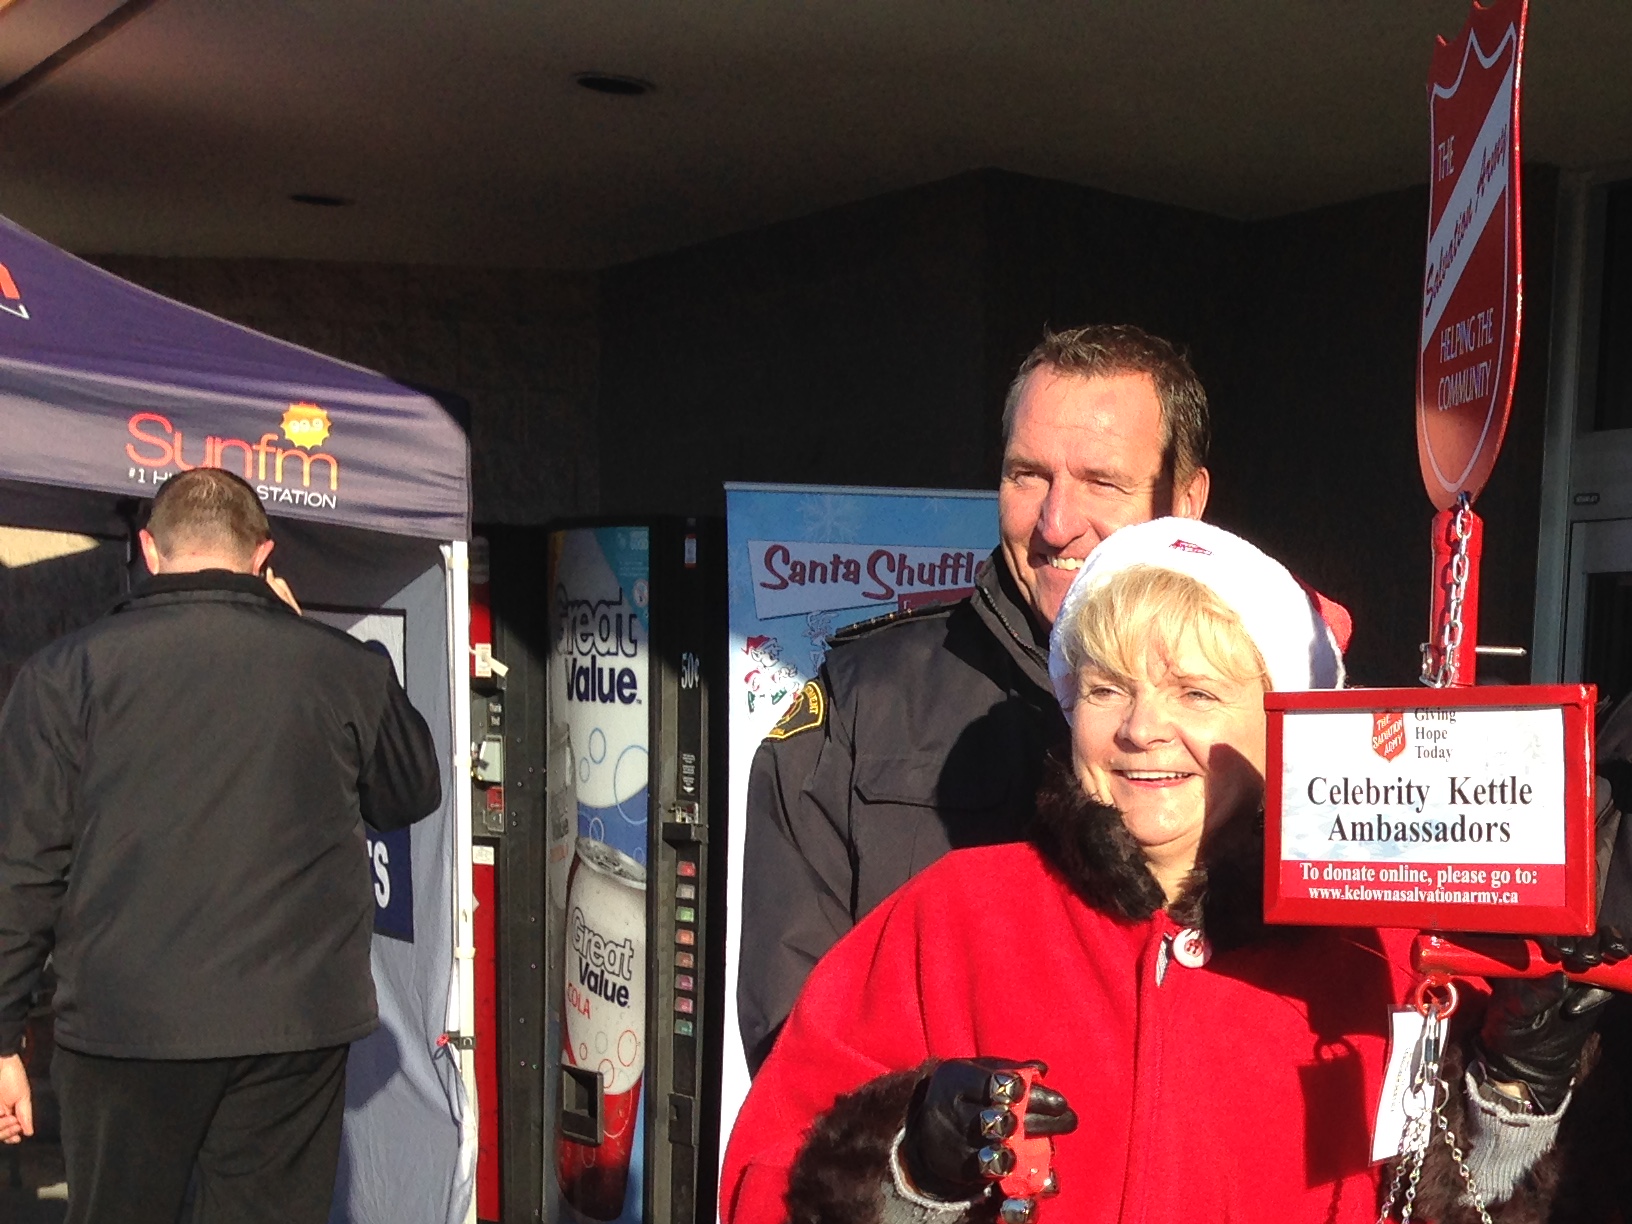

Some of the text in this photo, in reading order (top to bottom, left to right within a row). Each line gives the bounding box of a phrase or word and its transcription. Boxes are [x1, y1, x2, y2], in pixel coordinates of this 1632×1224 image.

[1438, 135, 1455, 182] THE
[1426, 124, 1507, 318] Salvation Army
[1440, 307, 1494, 363] HELPING THE
[1438, 359, 1493, 412] COMMUNITY
[256, 484, 337, 510] STATION
[759, 543, 861, 590] Santa
[556, 583, 638, 704] Great Value
[1414, 706, 1457, 725] Giving
[1414, 745, 1453, 762] Today
[1415, 726, 1448, 744] Hope
[1307, 775, 1533, 813] Celebrity Kettle
[1328, 813, 1511, 843] Ambassadors
[1300, 862, 1538, 889] To donate online, please go to:
[1308, 885, 1519, 905] www.kelownasalvationarmy.ca
[572, 906, 634, 1008] Great Value
[567, 982, 591, 1020] COLA
